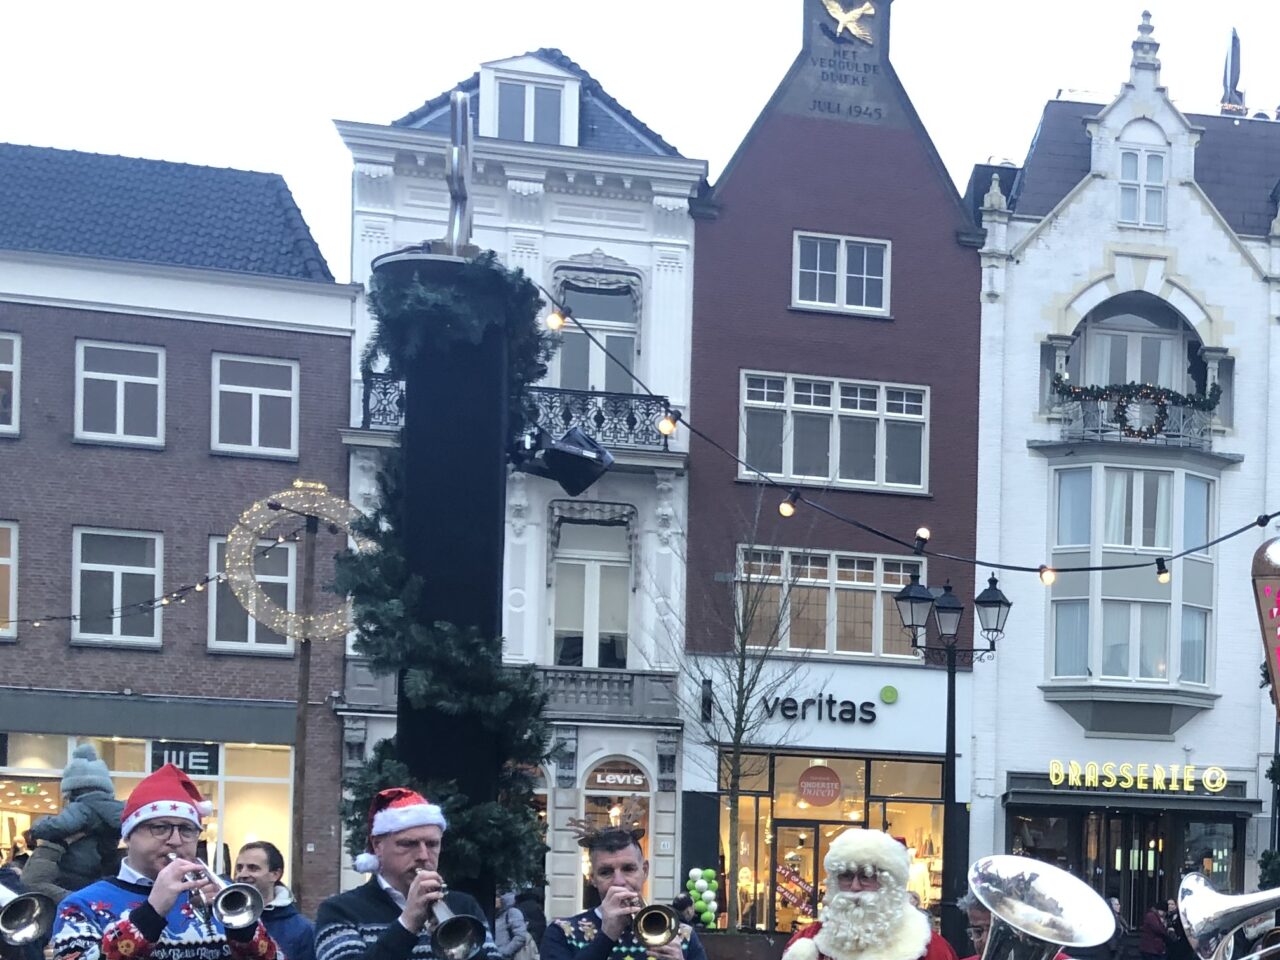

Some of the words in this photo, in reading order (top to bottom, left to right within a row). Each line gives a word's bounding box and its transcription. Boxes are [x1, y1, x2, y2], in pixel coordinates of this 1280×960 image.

[833, 49, 857, 61] HET
[811, 57, 879, 75] VERGULDE
[808, 100, 840, 114] JULI
[848, 104, 882, 120] 1945
[762, 693, 877, 724] veritas
[164, 750, 209, 770] WE
[1049, 759, 1196, 792] BRASSERIE
